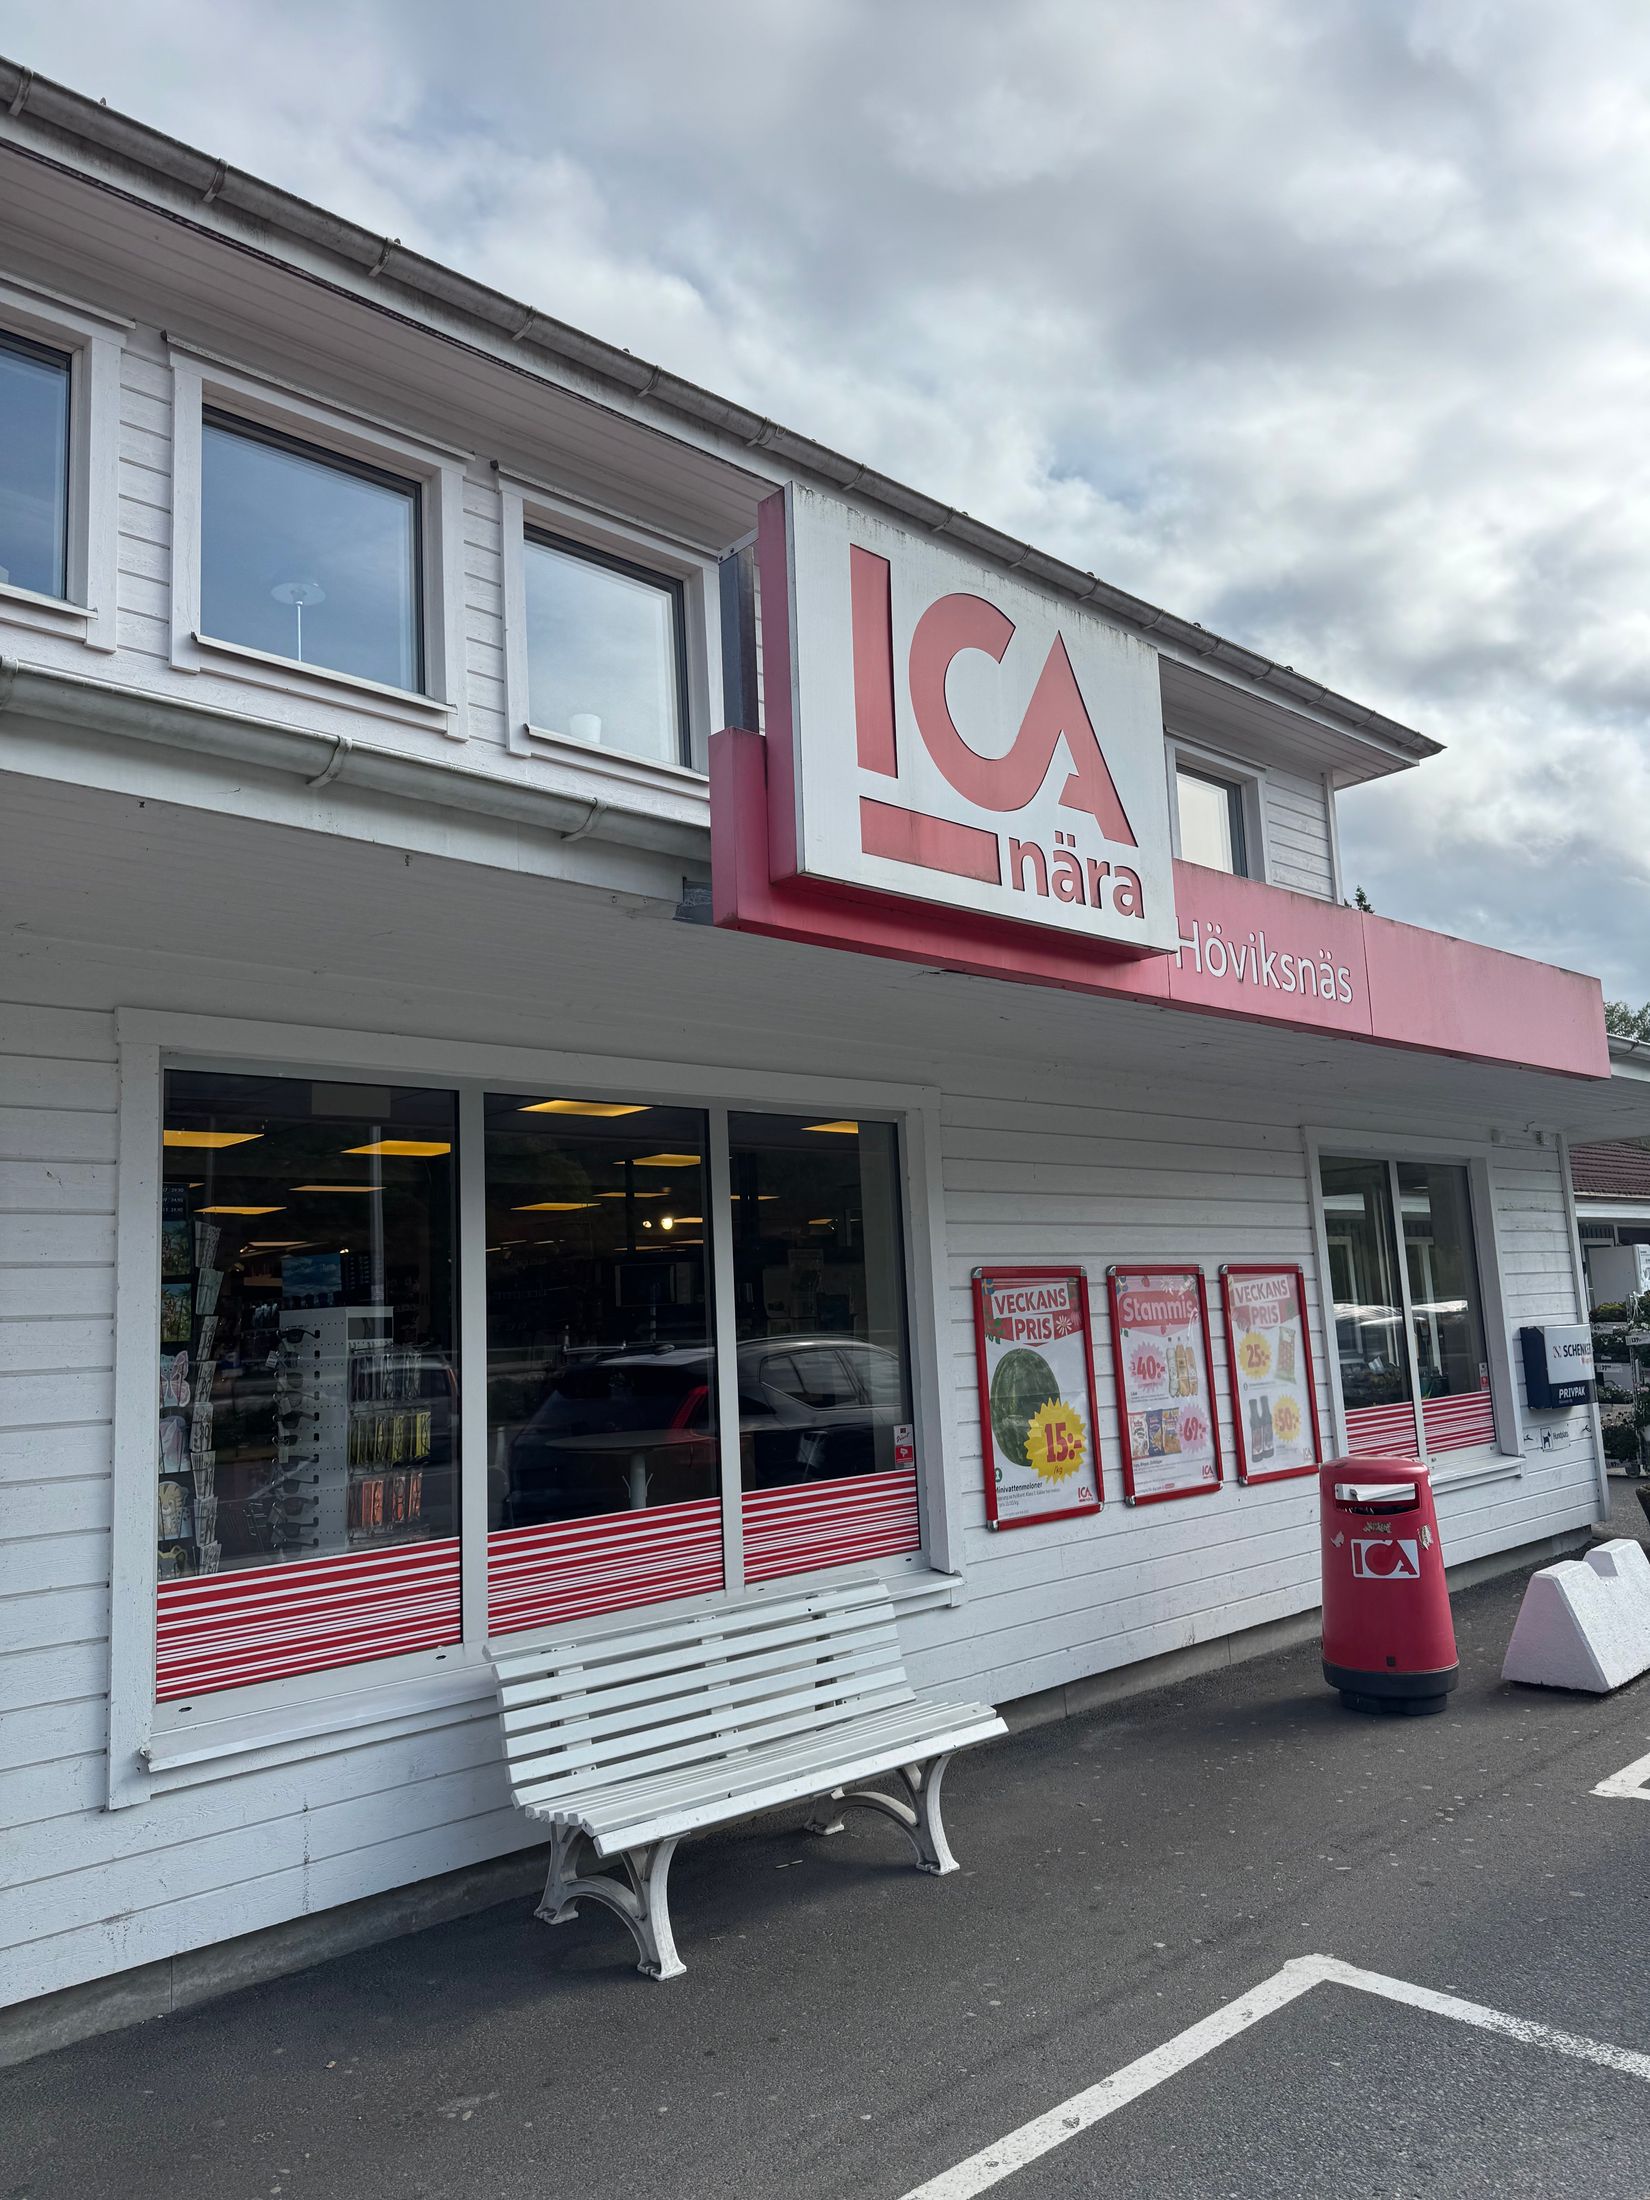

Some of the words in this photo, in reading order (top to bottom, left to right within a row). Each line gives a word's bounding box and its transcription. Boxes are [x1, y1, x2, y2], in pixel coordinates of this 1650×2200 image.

[850, 543, 1138, 847] ICA
[1009, 829, 1145, 919] nära
[1175, 915, 1353, 1004] Höviksnäs
[994, 1287, 1067, 1315] VECKANS
[1235, 1279, 1289, 1304] VECKANS
[1122, 1297, 1194, 1322] Stammis
[1250, 1304, 1279, 1325] PRIS
[1015, 1318, 1053, 1341] PRIS
[1559, 1386, 1586, 1400] PRIVPAK
[1044, 1422, 1083, 1463] 15:-
[1202, 1464, 1214, 1476] ICA
[1077, 1486, 1093, 1499] ICA
[1353, 1539, 1418, 1577] ICA
